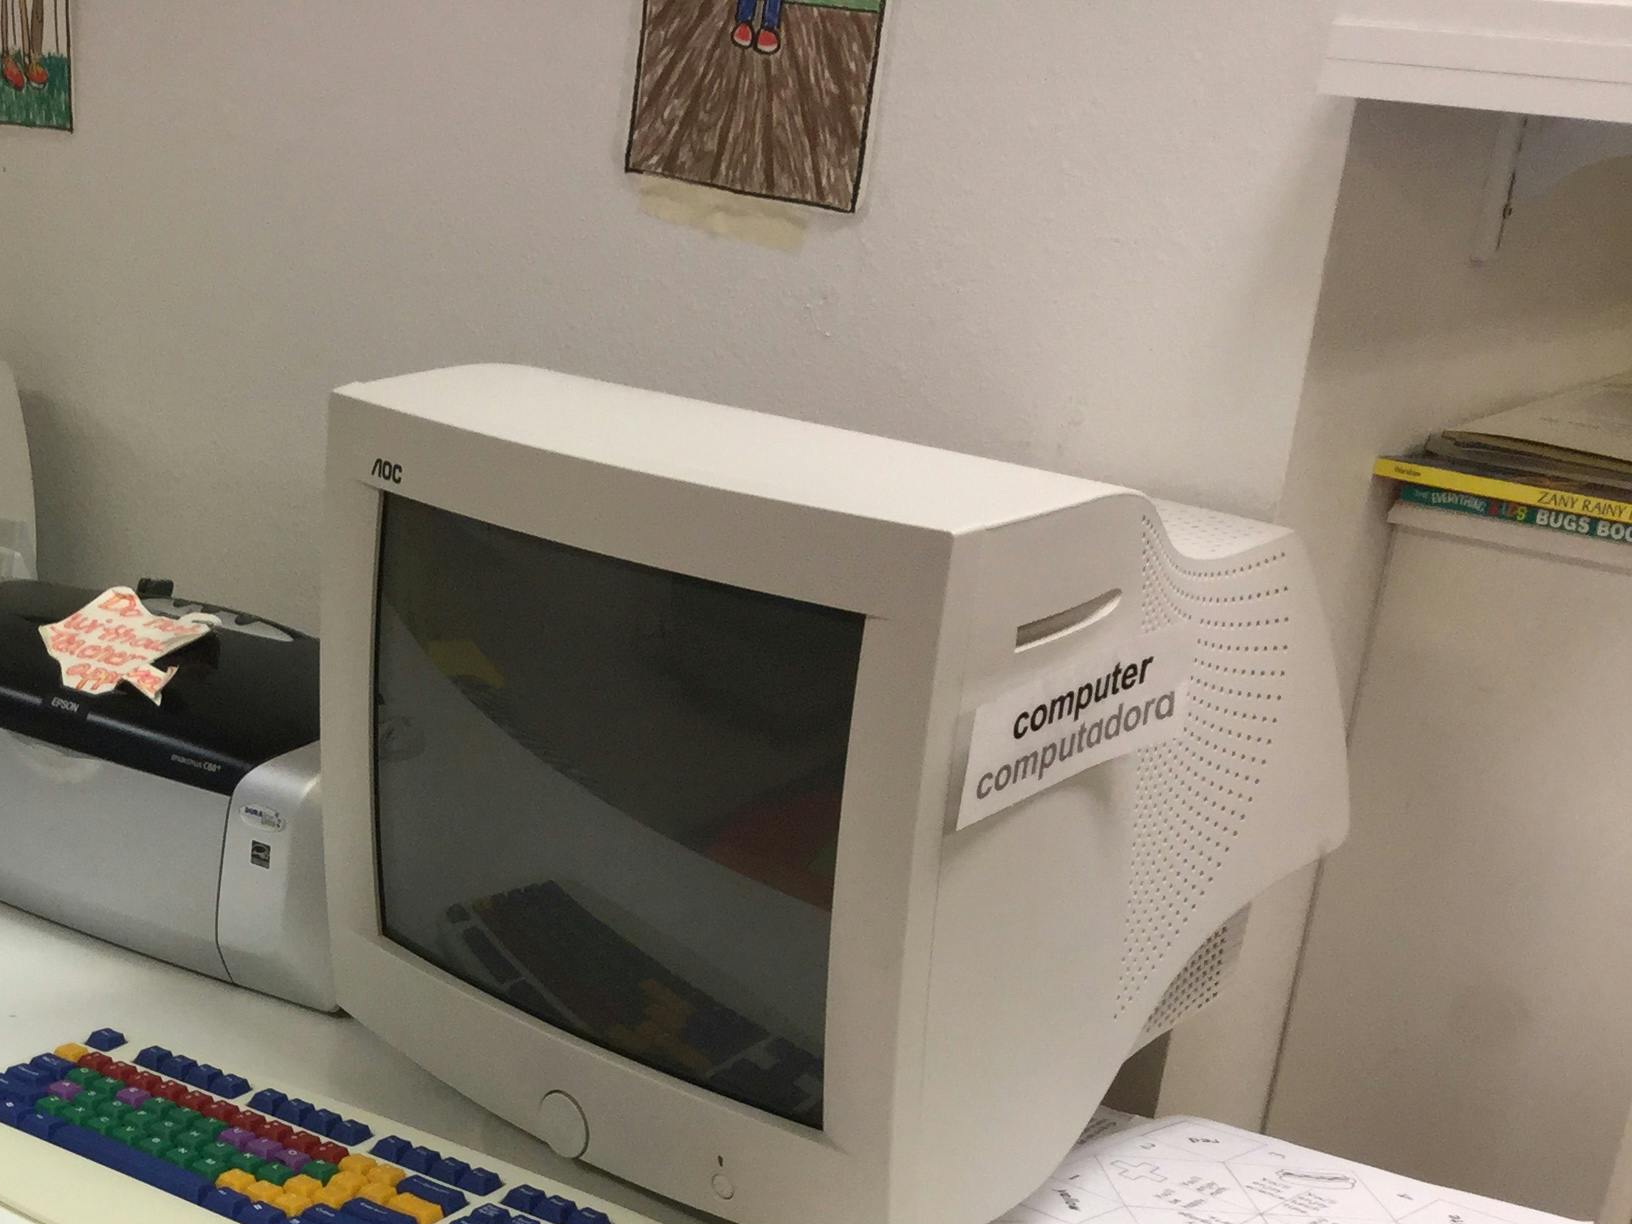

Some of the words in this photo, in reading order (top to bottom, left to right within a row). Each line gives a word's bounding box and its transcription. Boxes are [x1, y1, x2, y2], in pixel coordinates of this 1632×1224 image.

[1537, 491, 1577, 509] ZANY
[1581, 500, 1626, 520] RAINY
[1536, 509, 1591, 534] BUGS
[51, 696, 80, 713] EPSON
[1013, 656, 1154, 740] computer
[975, 690, 1176, 801] computadora
